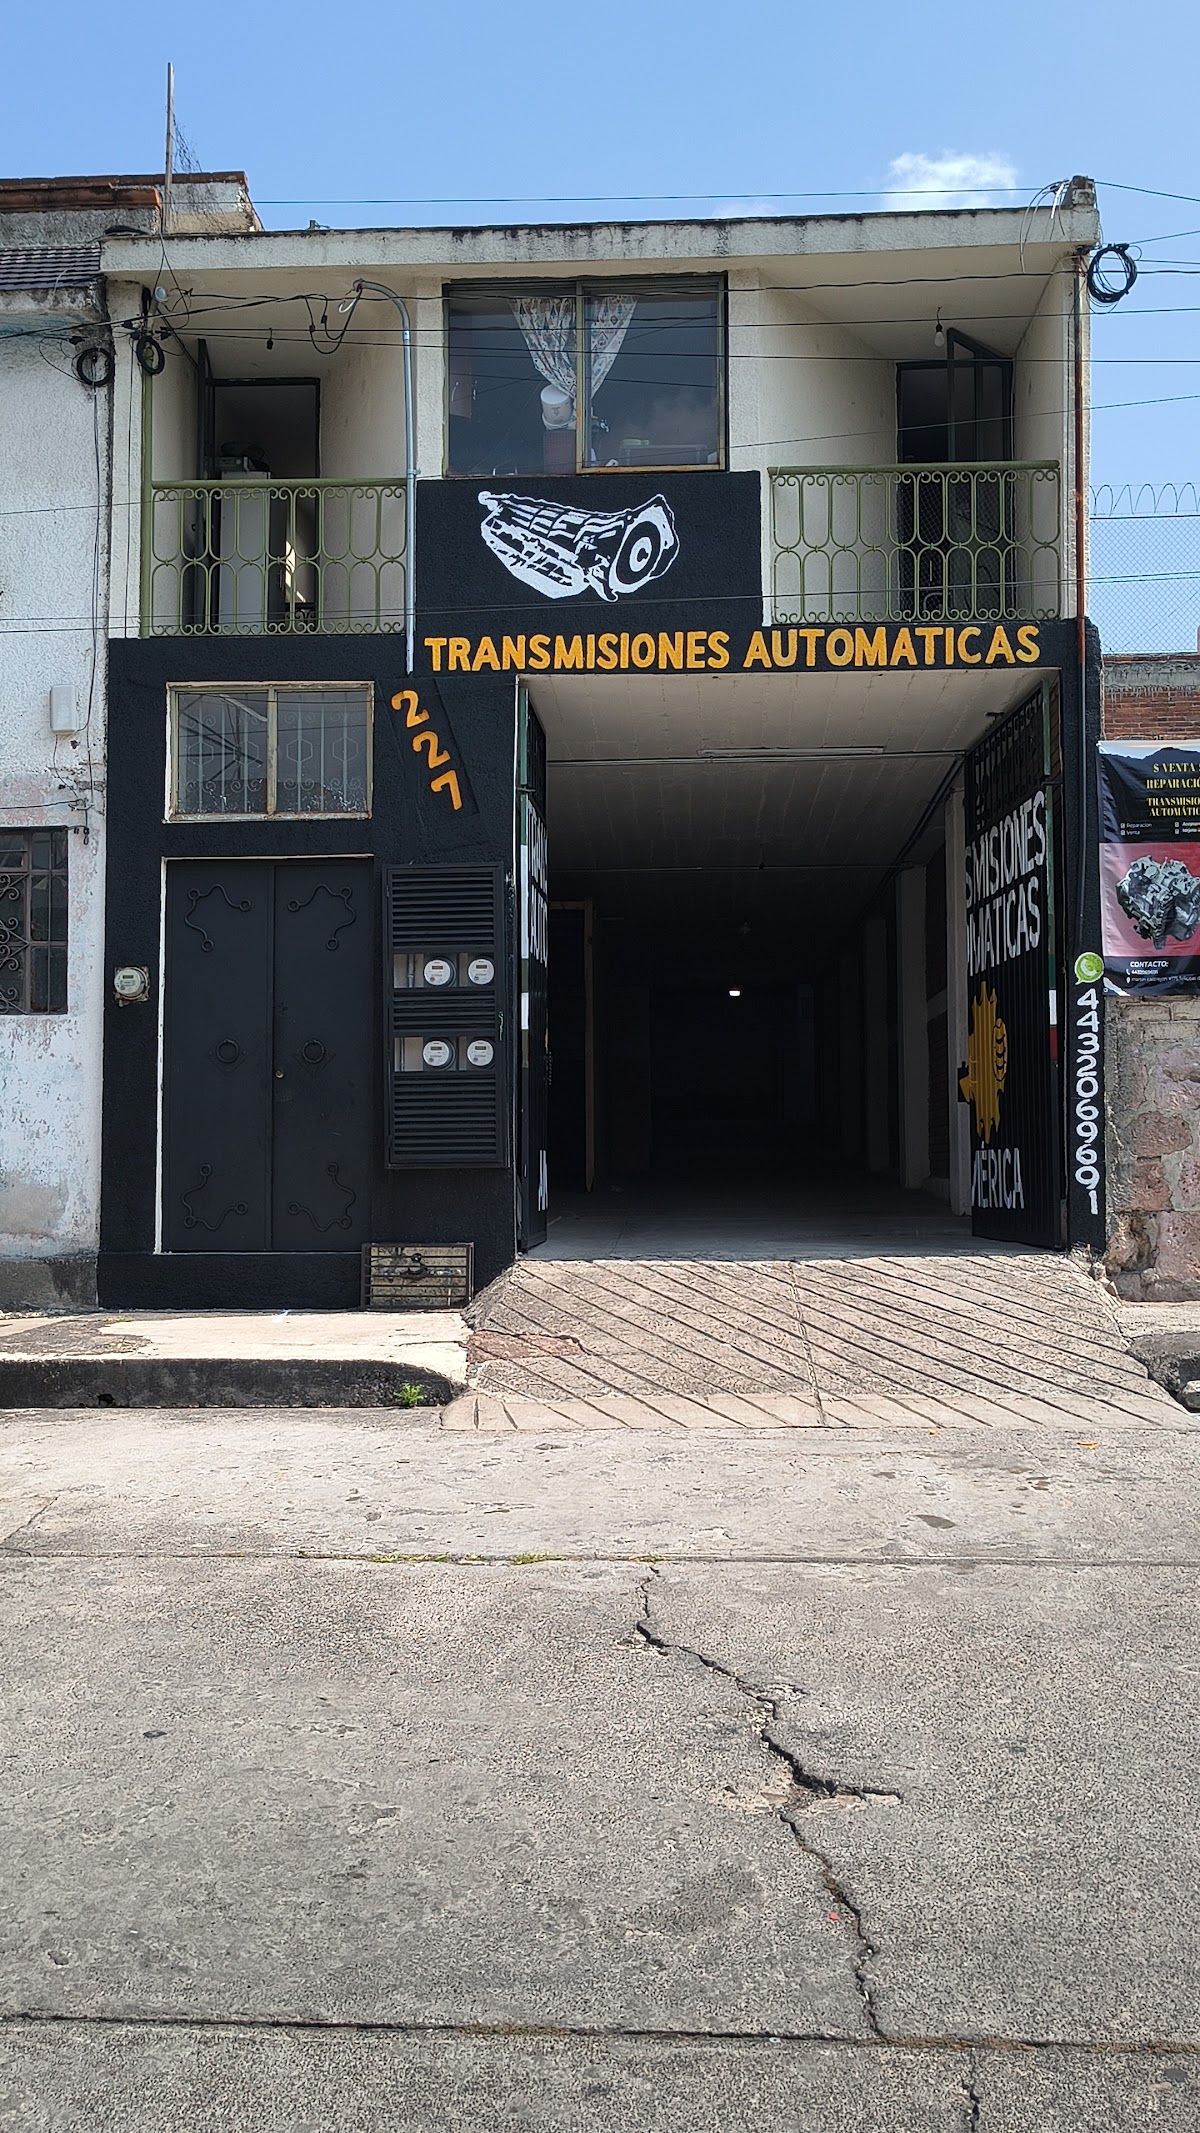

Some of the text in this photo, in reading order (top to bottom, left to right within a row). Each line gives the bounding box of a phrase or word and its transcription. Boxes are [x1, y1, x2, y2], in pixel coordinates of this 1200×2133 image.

[424, 625, 1041, 672] TRANSMISIONES AUTOMATICAS
[391, 689, 463, 811] 227
[1162, 762, 1196, 773] VENTA
[967, 876, 1041, 977] MATICAS
[1130, 960, 1169, 968] CONTACTO:
[1075, 988, 1100, 1215] 4432069691
